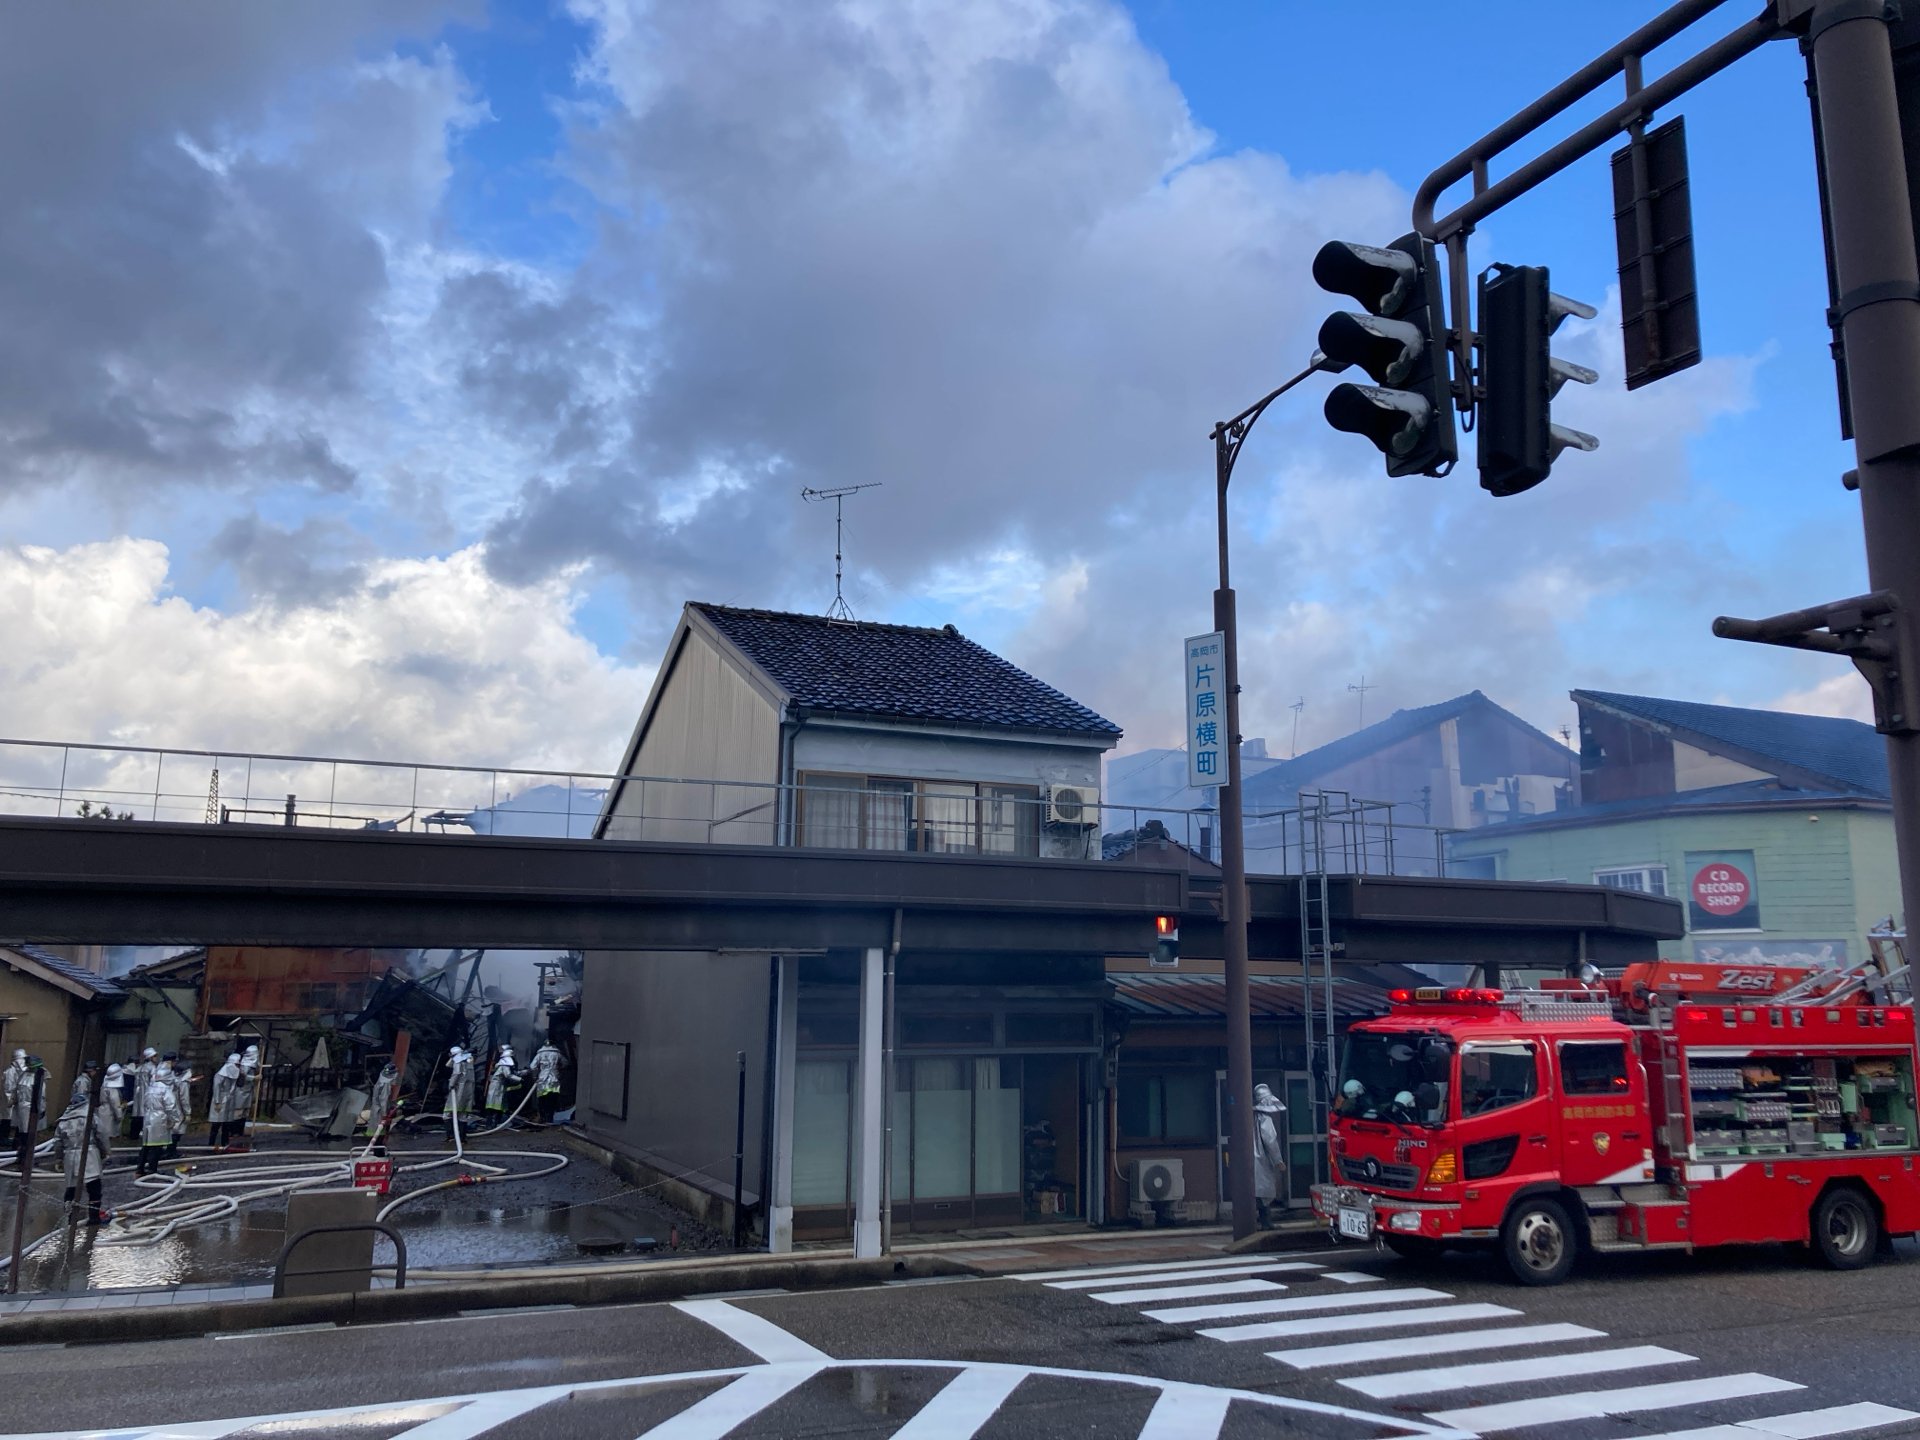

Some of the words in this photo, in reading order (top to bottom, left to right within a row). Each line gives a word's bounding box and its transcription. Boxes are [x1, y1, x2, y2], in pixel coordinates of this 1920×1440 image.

[1190, 644, 1219, 659] 高岡市
[1195, 663, 1218, 775] 片原横町
[1710, 871, 1729, 881] CD
[1699, 883, 1744, 893] RECORD
[1707, 896, 1740, 906] SHOP
[1717, 969, 1776, 990] Zest
[1398, 1138, 1428, 1149] HINO
